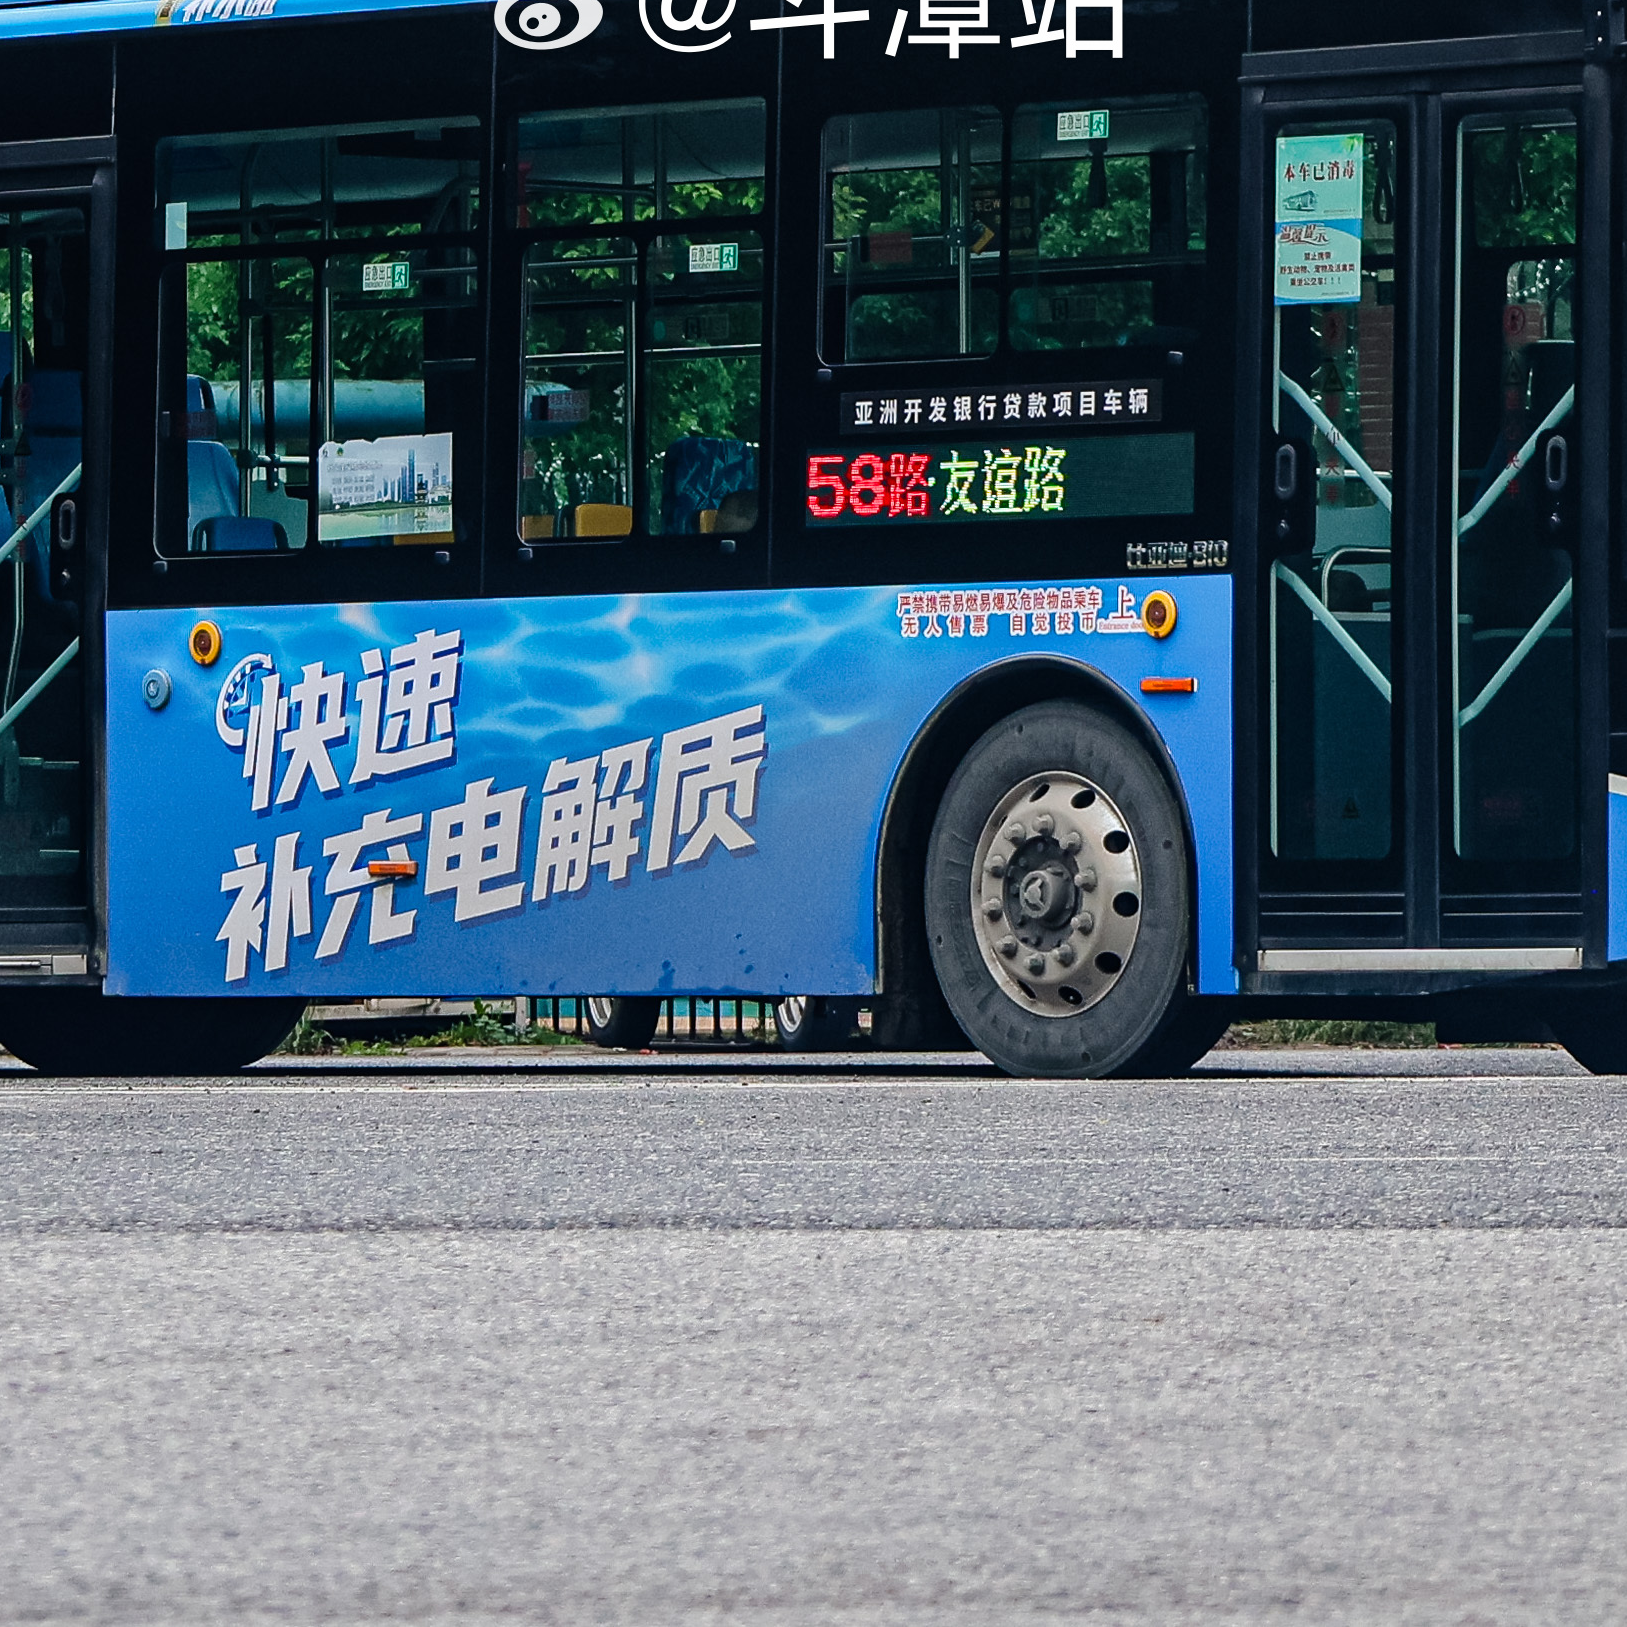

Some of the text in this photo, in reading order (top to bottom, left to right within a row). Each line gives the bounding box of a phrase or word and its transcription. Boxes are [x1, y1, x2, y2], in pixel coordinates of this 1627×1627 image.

[1284, 159, 1355, 182] 本车已消毒
[853, 387, 1150, 426] 亚洲开发银行贷款项目车辆
[898, 588, 1102, 615] 严禁携带易燃易爆及危险物品乘车
[1111, 589, 1134, 619] 上
[902, 611, 1095, 637] 无人售票 自觉投币
[243, 628, 463, 812] 快速
[215, 704, 764, 983] 补充电解质
